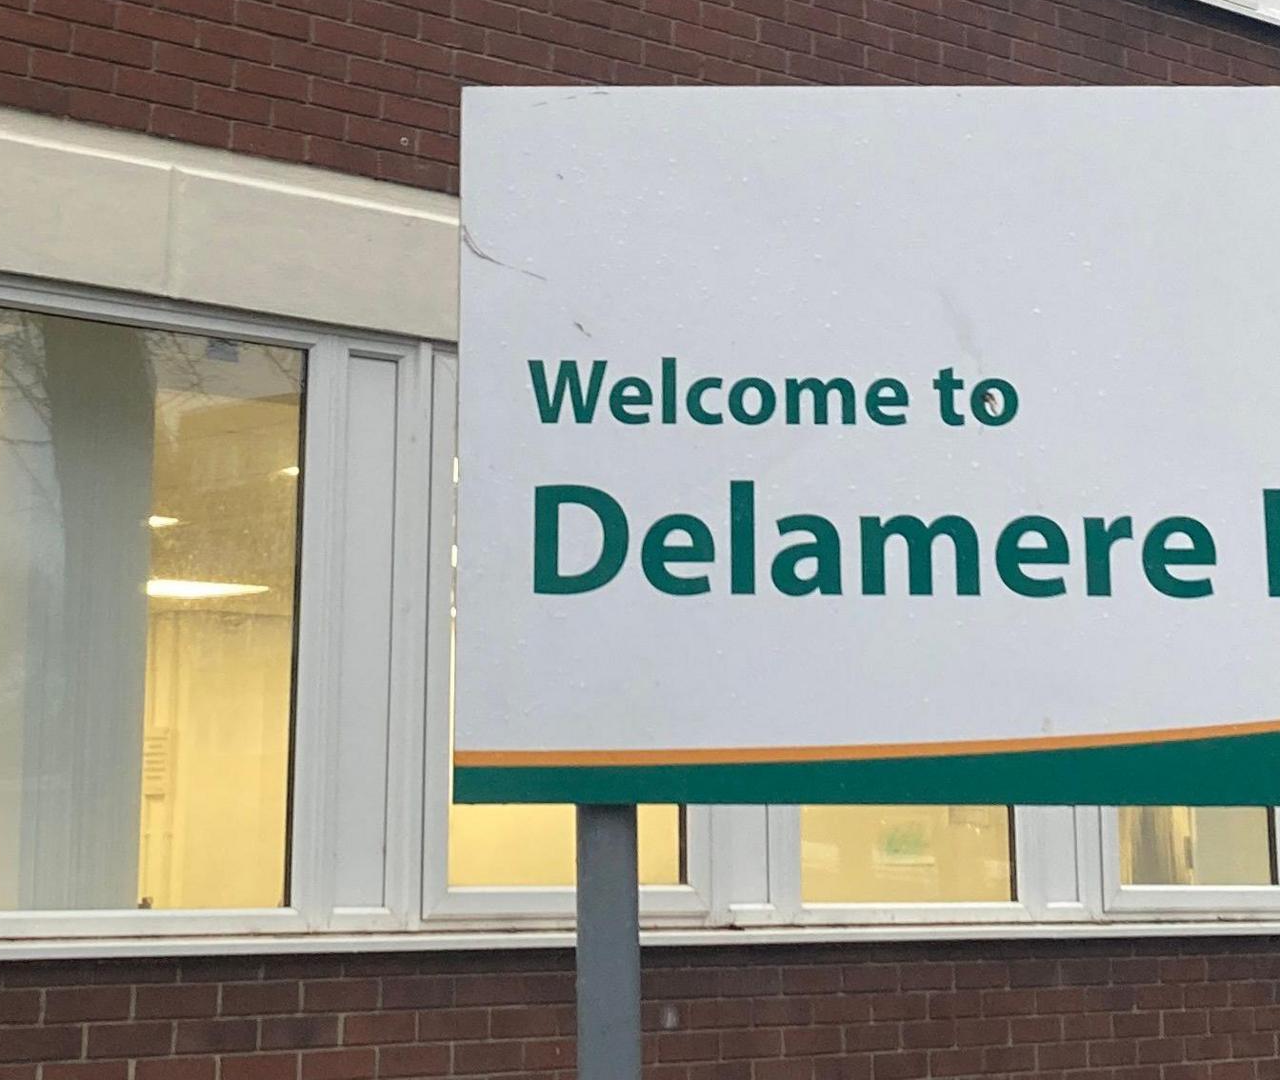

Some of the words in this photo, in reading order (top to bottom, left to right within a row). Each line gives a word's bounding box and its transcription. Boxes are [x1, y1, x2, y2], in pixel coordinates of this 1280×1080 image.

[527, 356, 910, 428] Welcome
[932, 367, 1021, 428] to
[532, 480, 1218, 600] Delamere
